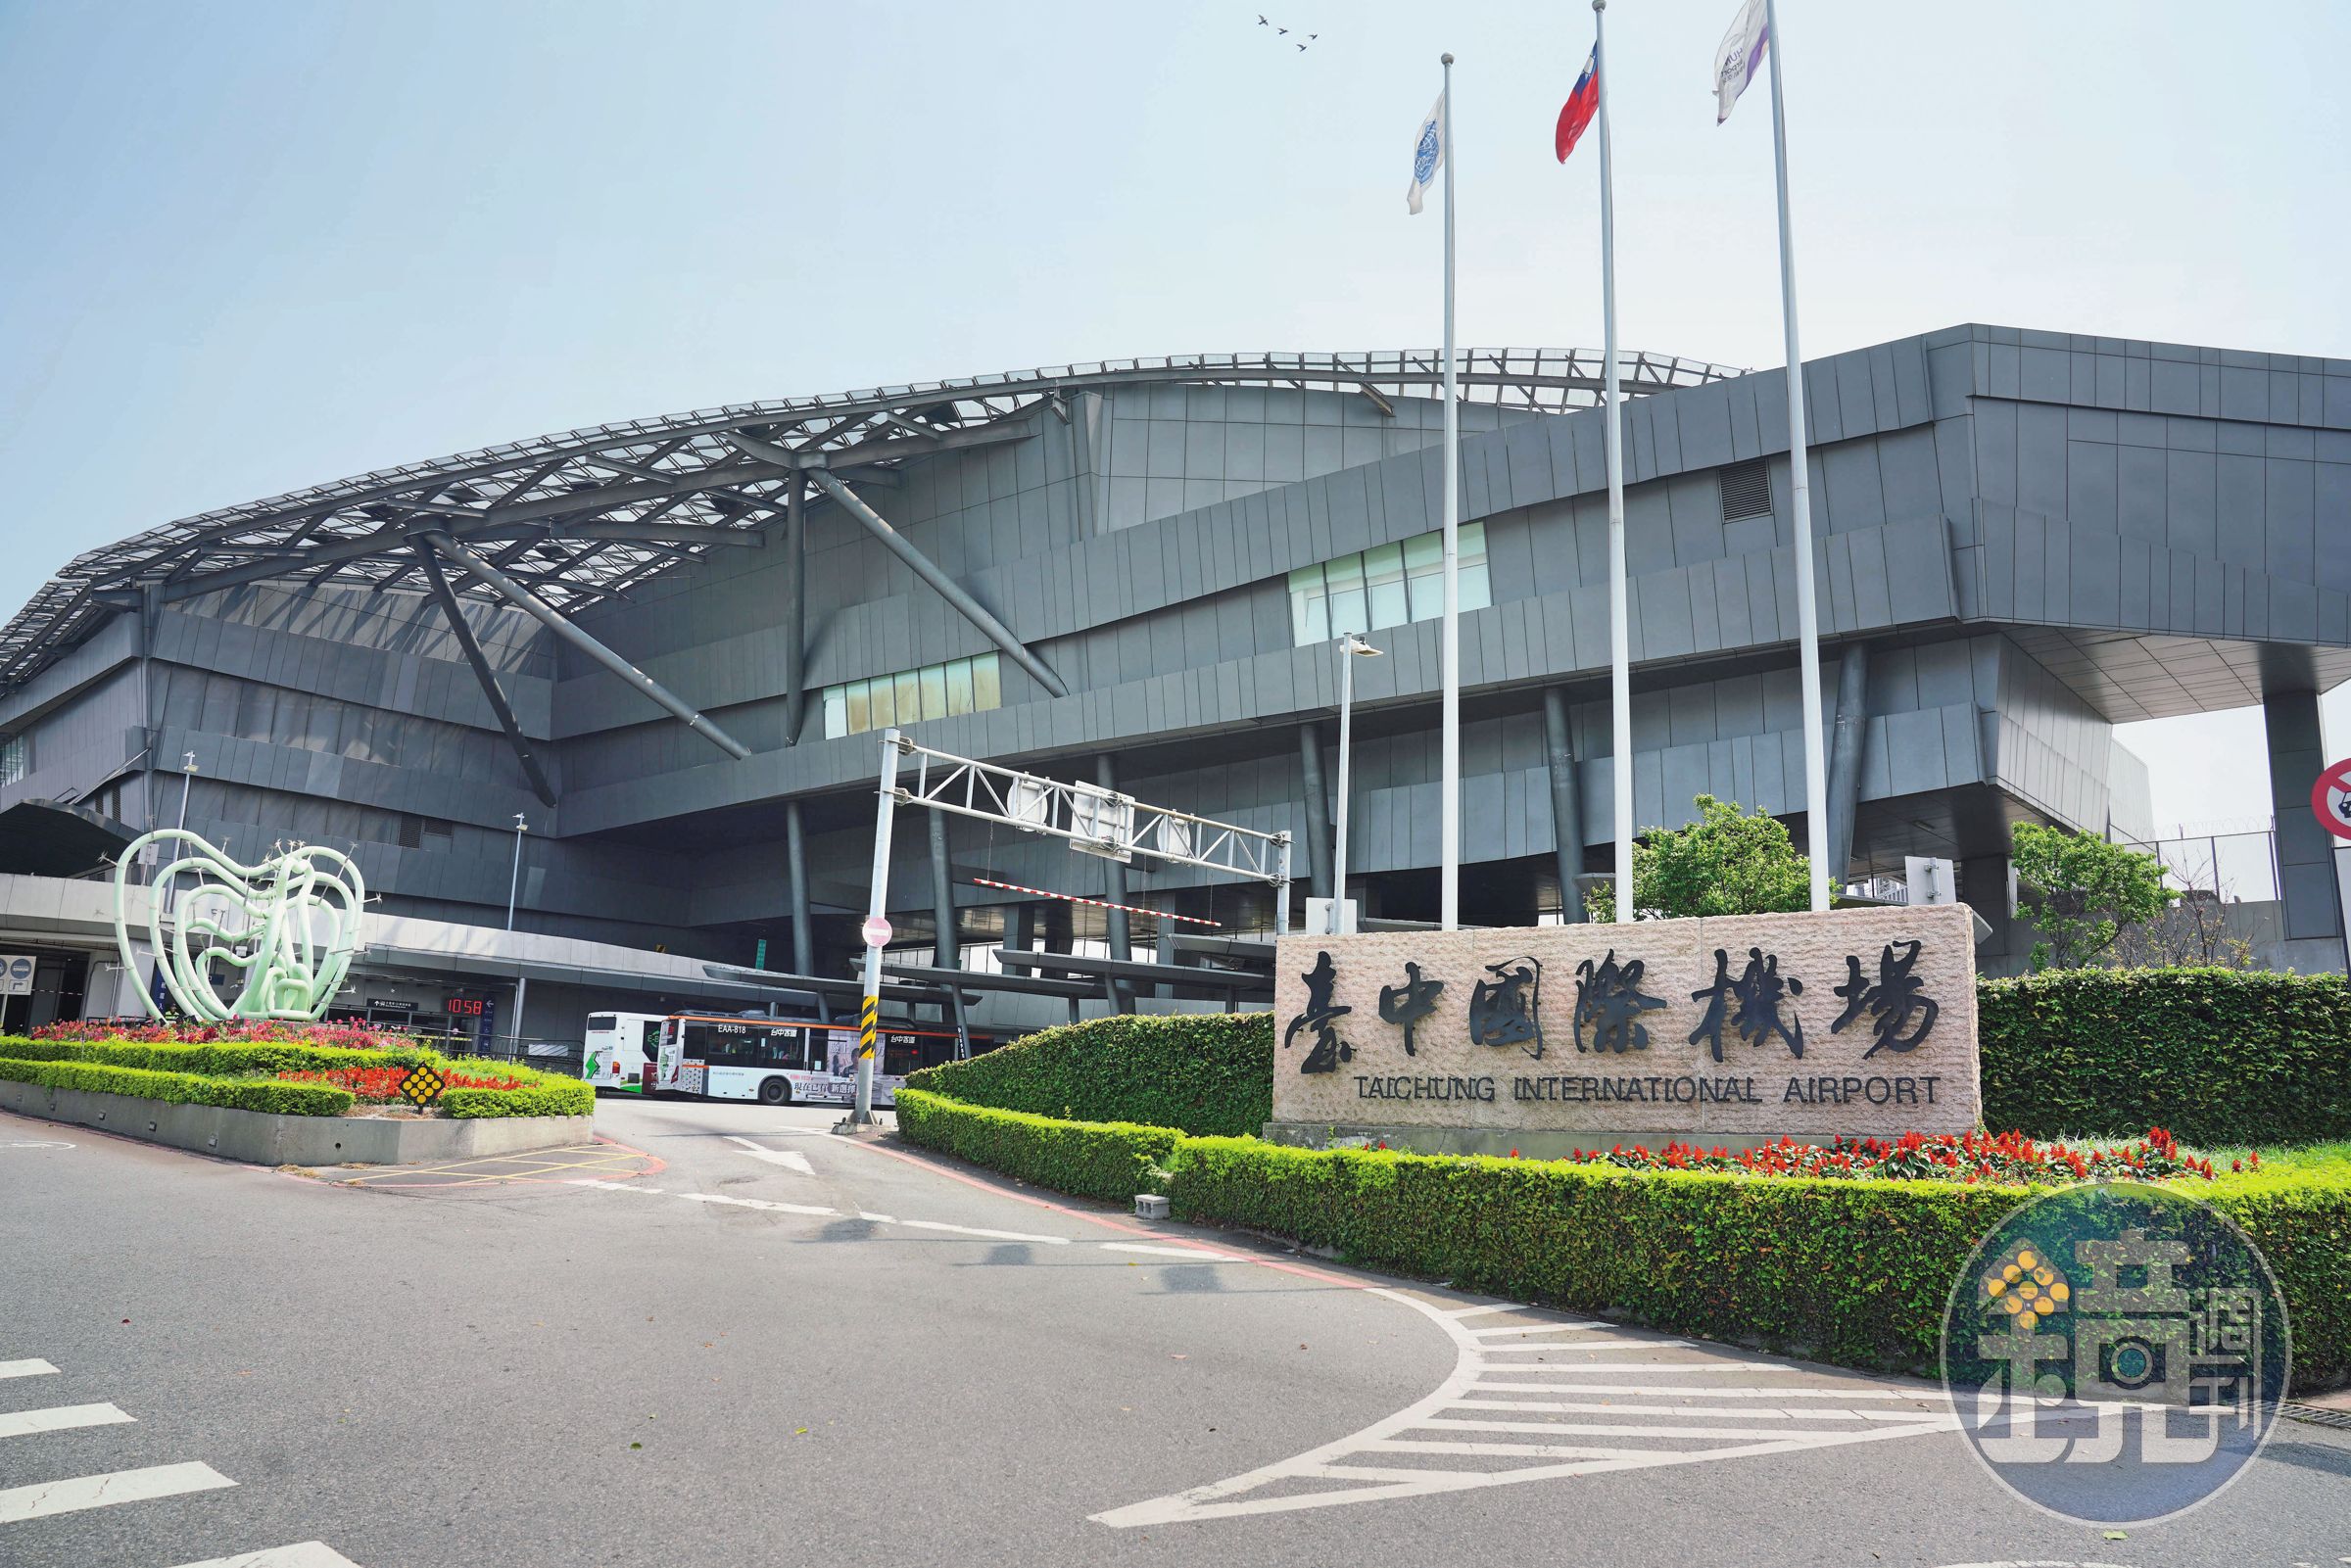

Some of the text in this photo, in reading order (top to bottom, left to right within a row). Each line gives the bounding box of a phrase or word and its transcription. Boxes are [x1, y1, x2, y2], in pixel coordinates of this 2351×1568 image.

[718, 1024, 746, 1034] EAA-818
[1354, 1077, 1942, 1104] TAICHUNG INTERNATIONAL AIRPORT
